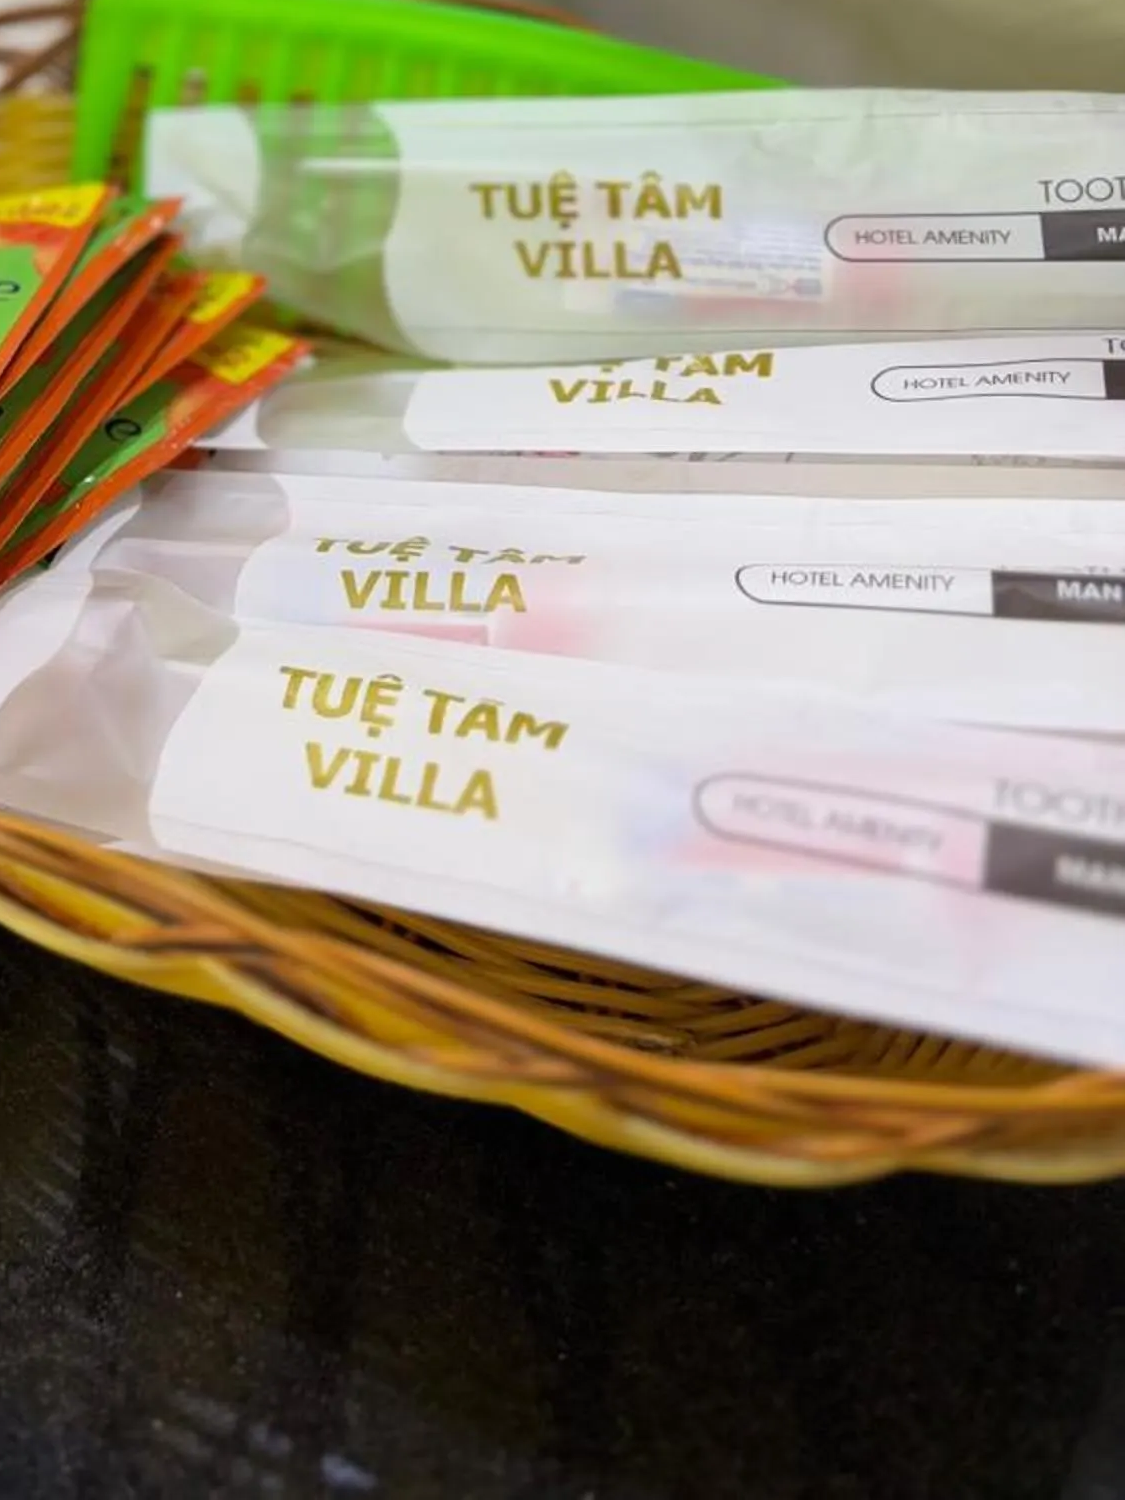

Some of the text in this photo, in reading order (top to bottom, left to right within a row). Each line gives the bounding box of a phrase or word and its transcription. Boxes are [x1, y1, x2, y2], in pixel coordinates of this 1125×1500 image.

[468, 169, 724, 229] TUỆ TÂM
[855, 228, 1012, 246] HOTEL AMENITY
[513, 239, 684, 281] VILLA
[549, 378, 724, 405] VILLA
[903, 370, 1071, 391] HOTEL AMENITY
[313, 536, 431, 563] TUỆ
[340, 569, 527, 613] VILLA
[771, 570, 955, 593] HOTEL AMENITY
[279, 665, 404, 738] TUỆ
[305, 741, 499, 820] VILLA
